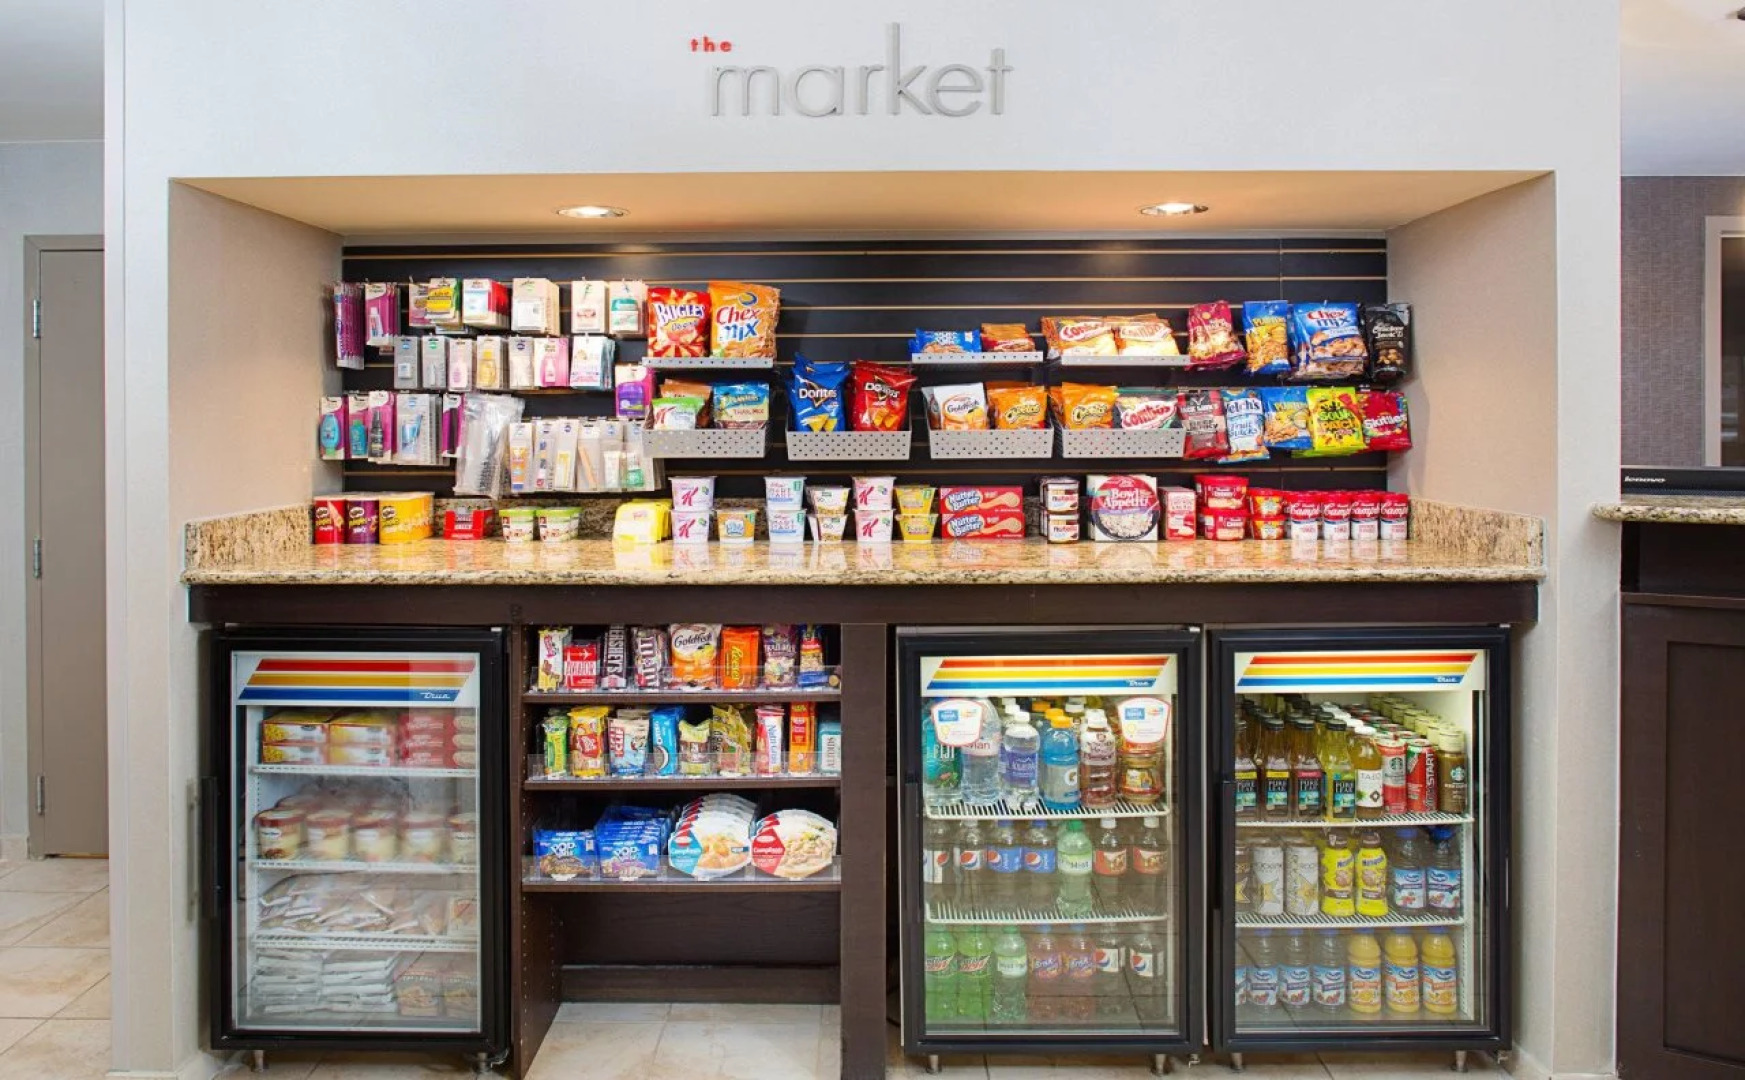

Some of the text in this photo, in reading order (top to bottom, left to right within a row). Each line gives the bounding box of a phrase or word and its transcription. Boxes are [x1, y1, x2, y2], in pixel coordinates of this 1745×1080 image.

[690, 36, 733, 52] the
[709, 22, 1014, 117] market
[716, 306, 760, 325] Chex
[1306, 309, 1345, 320] Chex
[798, 388, 837, 399] Doritos
[864, 382, 900, 398] Doritos
[946, 400, 980, 413] Goldfish
[1122, 405, 1170, 426] Combos
[1364, 413, 1407, 428] Skittles
[949, 489, 977, 501] Nutter
[1112, 488, 1138, 499] Bowl
[953, 497, 980, 511] Butter
[950, 515, 978, 527] Nutter
[953, 523, 981, 537] Butter
[674, 633, 713, 646] Goldfish
